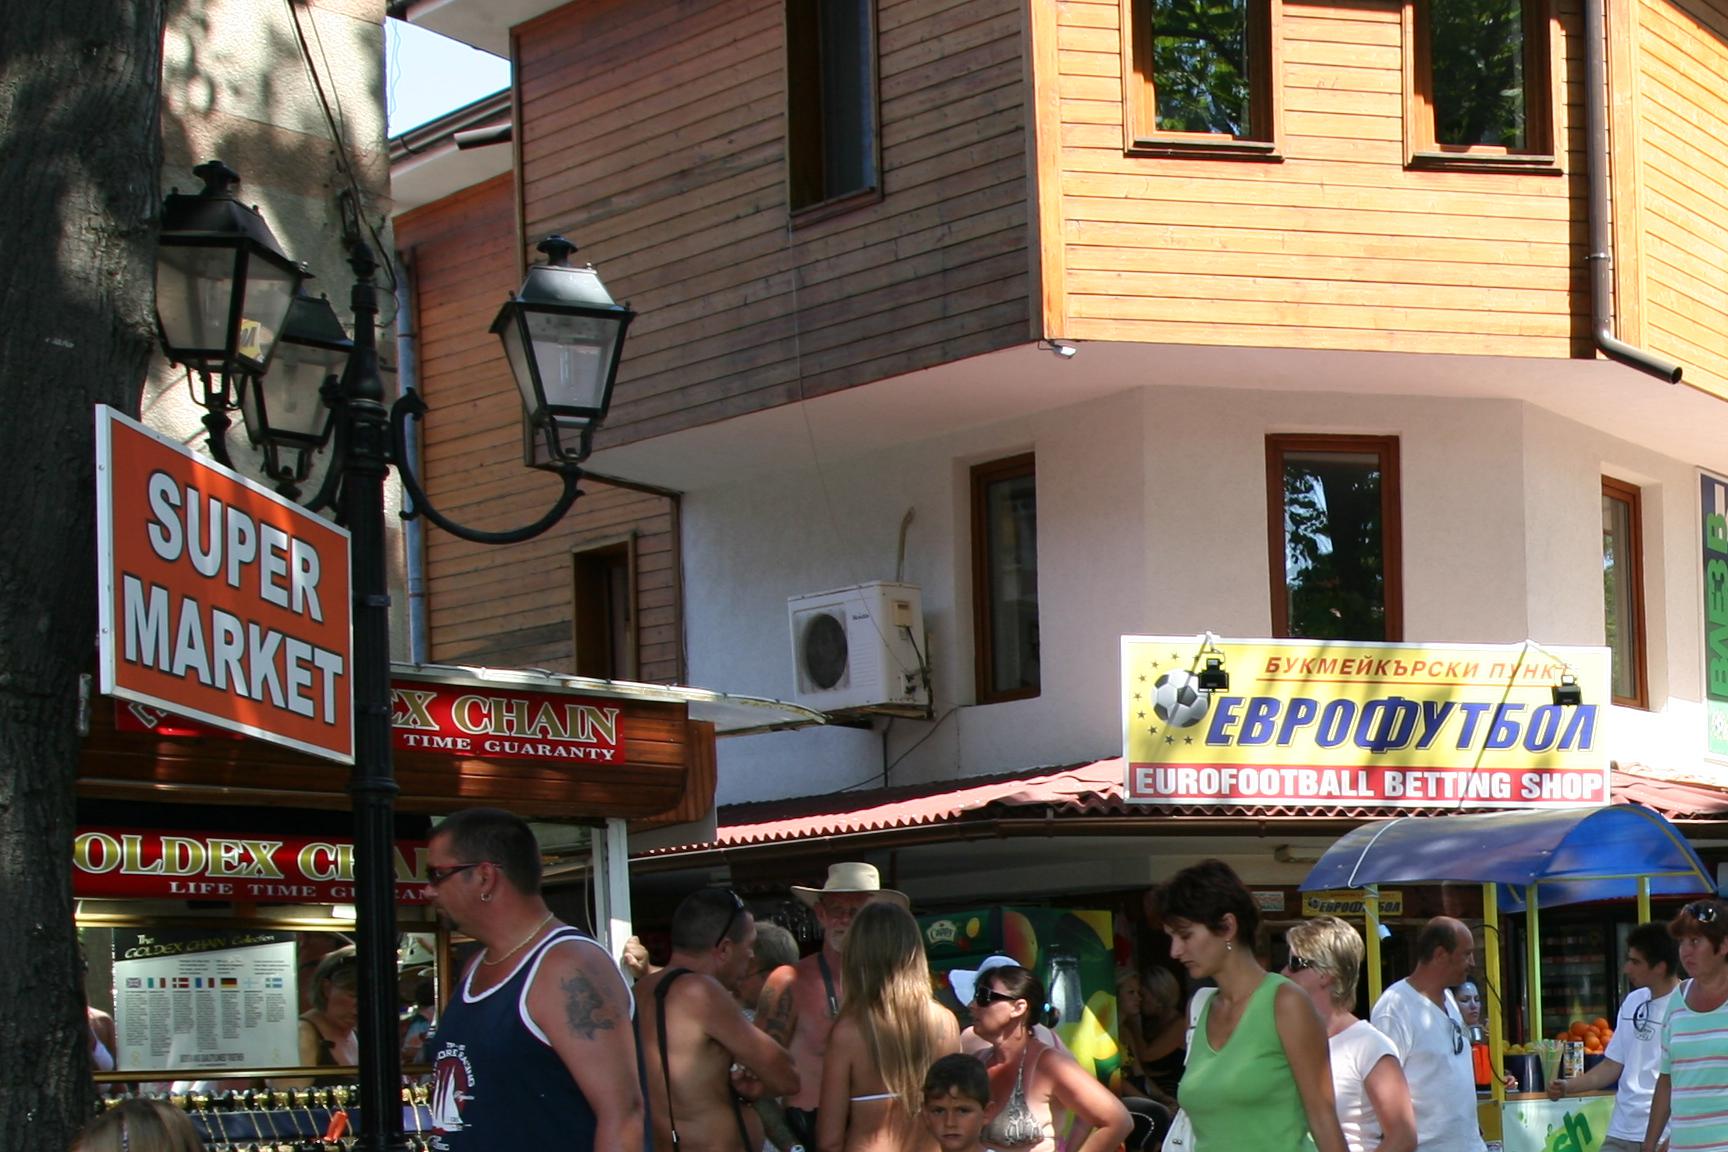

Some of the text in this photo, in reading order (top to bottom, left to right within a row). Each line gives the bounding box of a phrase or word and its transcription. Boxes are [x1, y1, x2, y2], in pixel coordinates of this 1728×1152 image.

[147, 469, 324, 623] SUPER
[123, 573, 343, 726] MARKET
[1265, 654, 1479, 681] БУКМЕЙКЪРСКИ
[452, 694, 620, 746] CHAIN
[1205, 696, 1600, 754] ЕВРОФУТБОЛ
[404, 734, 615, 761] TIME GUARANTY
[1135, 767, 1604, 800] EUROFOOTBALL BETTING SHOP
[73, 832, 285, 879] OLDEX
[169, 880, 233, 895] LIFE
[252, 883, 317, 897] TIME
[124, 943, 182, 959] GOLDEX
[136, 934, 154, 945] The
